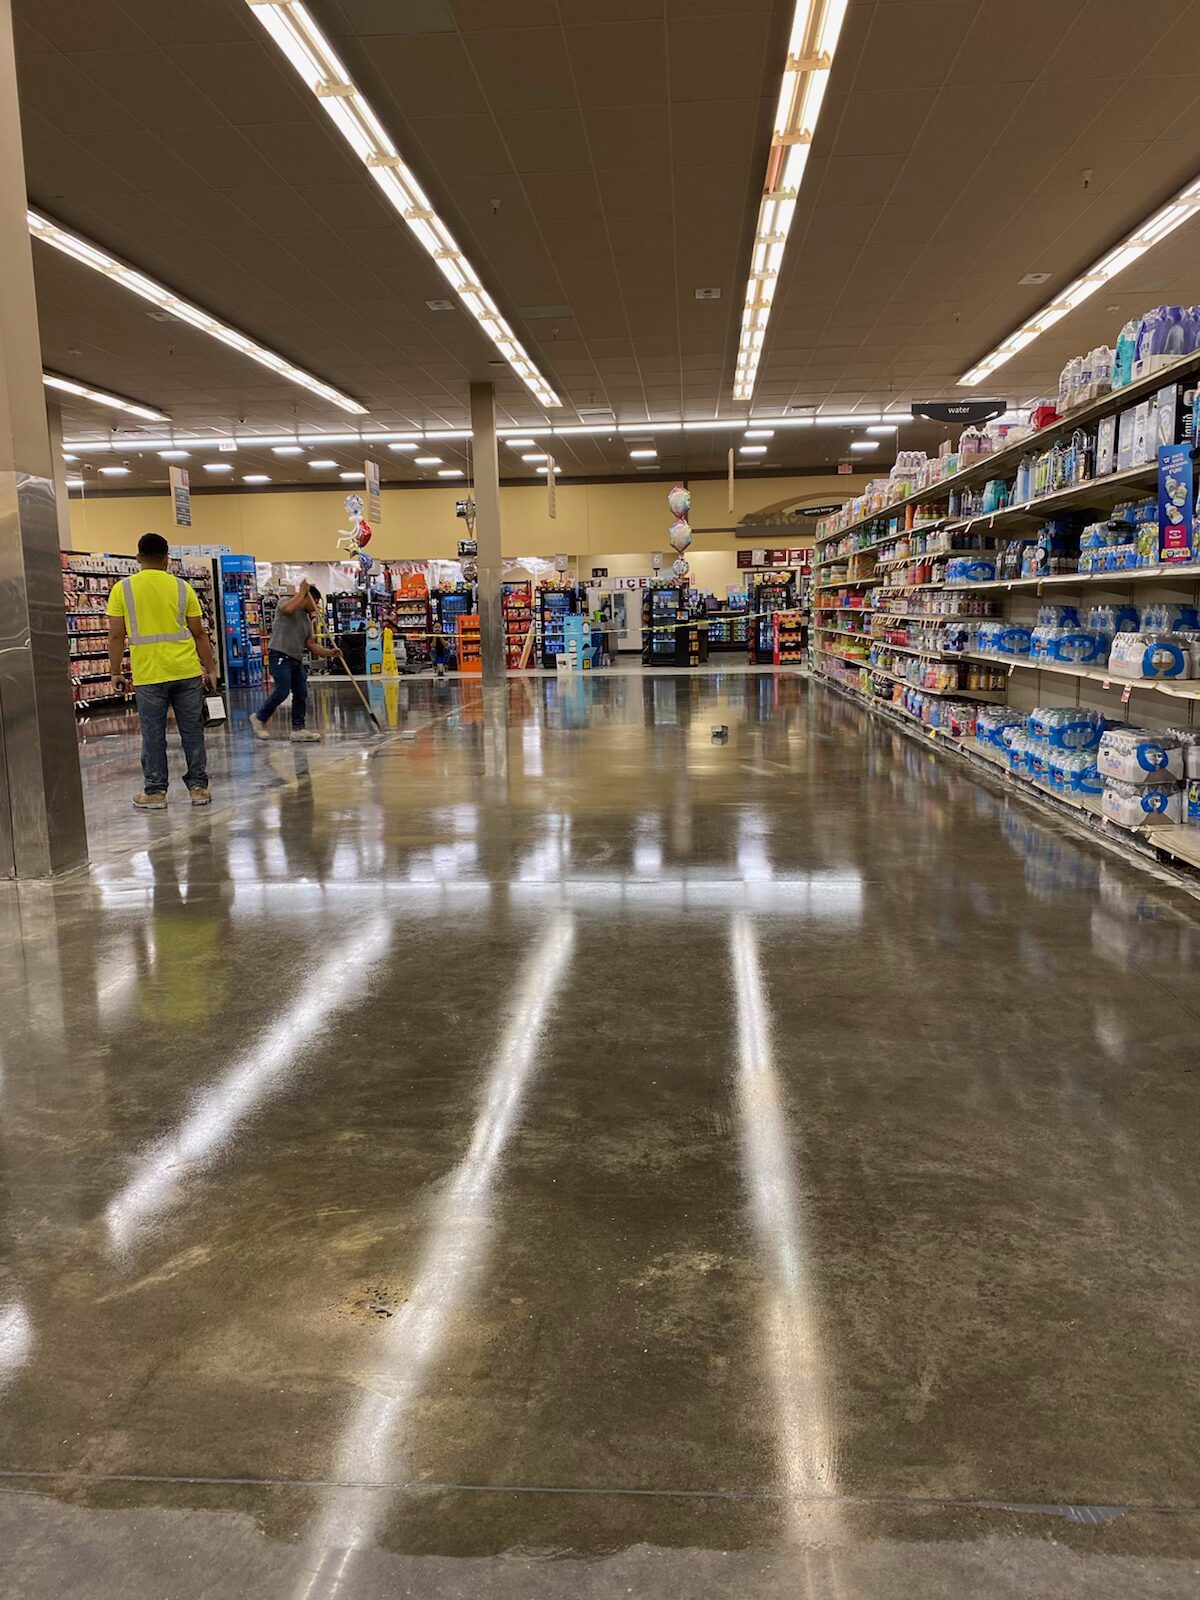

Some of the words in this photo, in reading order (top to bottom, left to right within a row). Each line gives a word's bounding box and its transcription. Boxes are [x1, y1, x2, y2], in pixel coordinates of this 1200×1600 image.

[947, 406, 971, 414] water
[653, 555, 660, 564] 6
[755, 551, 761, 561] 7
[273, 566, 280, 575] 2
[619, 578, 647, 588] ICE
